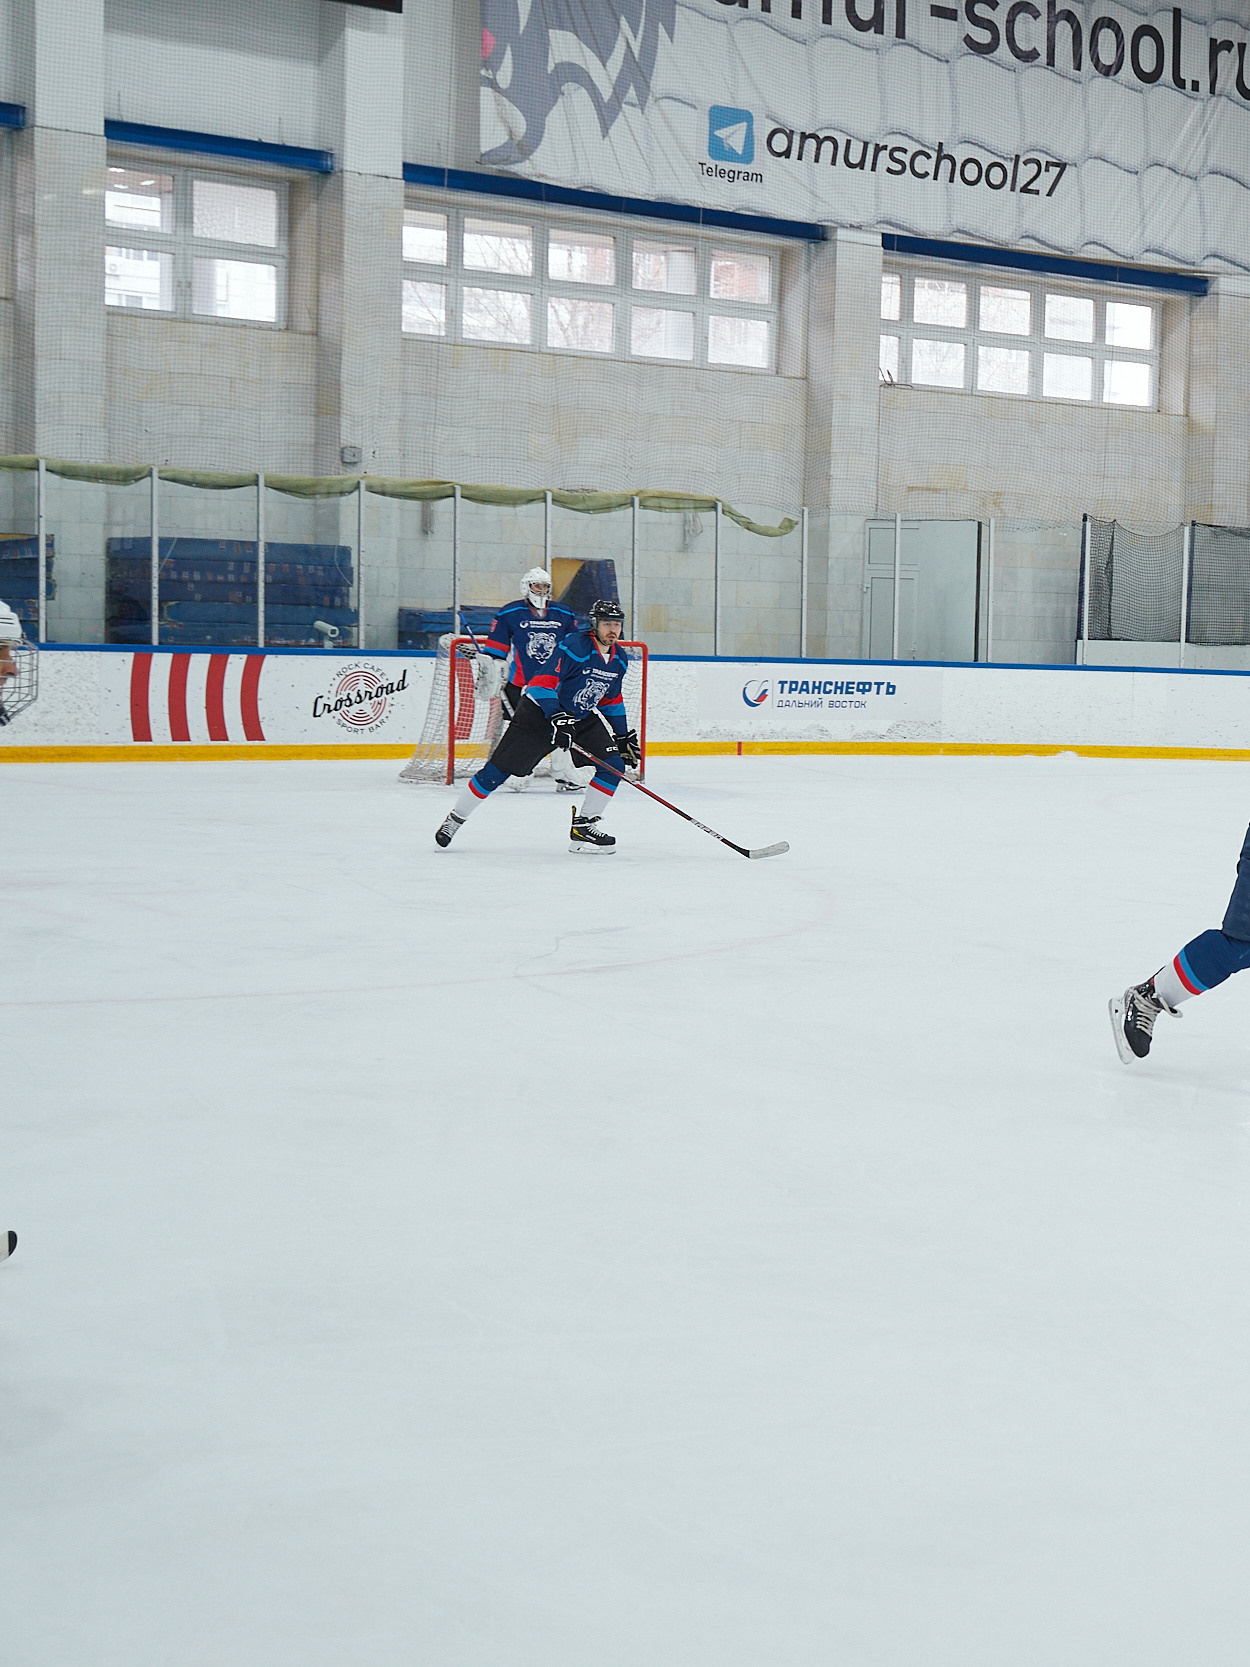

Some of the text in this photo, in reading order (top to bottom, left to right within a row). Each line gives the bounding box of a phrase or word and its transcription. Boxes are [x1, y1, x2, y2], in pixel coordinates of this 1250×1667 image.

[766, 125, 1068, 198] amurschool27
[698, 162, 764, 184] Telegram
[336, 661, 388, 680] ROCK CAFE
[312, 668, 410, 718] Crossroad
[777, 680, 897, 696] ТРАНСНЕФТЬ
[776, 697, 867, 709] ДАЛЬНИЙ ВОСТОК
[335, 718, 386, 734] SPORT BAR
